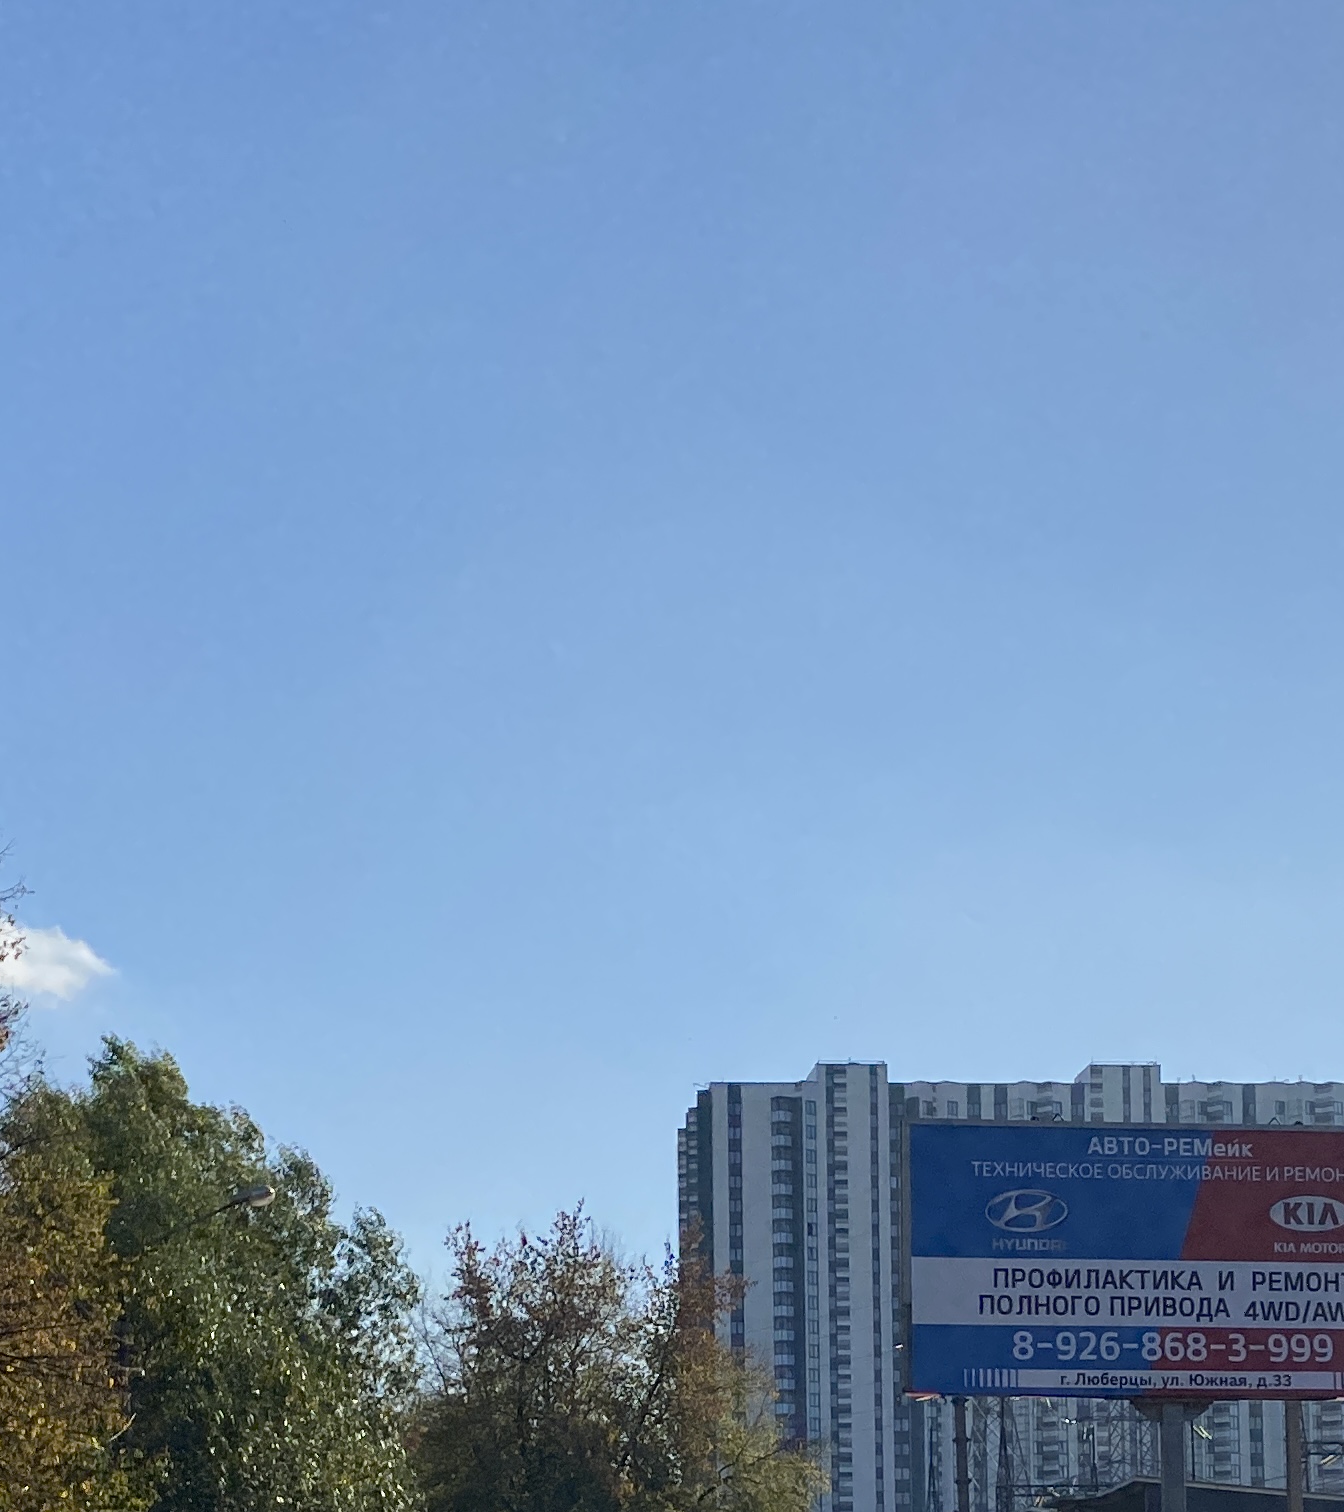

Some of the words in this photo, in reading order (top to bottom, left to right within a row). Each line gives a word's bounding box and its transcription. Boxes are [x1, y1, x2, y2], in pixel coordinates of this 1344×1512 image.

[1087, 1137, 1253, 1158] АВТО-РЕМейк
[971, 1161, 1103, 1179] ТЕХНИЧЕСКОЕ
[1107, 1163, 1262, 1182] ОБСЛУЖИВАНИЕ
[1266, 1166, 1279, 1181] И
[1283, 1201, 1340, 1225] KIA
[1273, 1242, 1296, 1253] KIA
[992, 1267, 1204, 1291] ПРОФИЛАКТИКА
[1218, 1271, 1235, 1291] И
[978, 1294, 1101, 1316] ПОЛНОГО
[1109, 1296, 1231, 1322] ПРИВОДА
[1012, 1330, 1334, 1363] 8-926-868-3-999
[1060, 1375, 1070, 1386] г.
[1074, 1373, 1157, 1389] Люберцы,
[1161, 1375, 1184, 1388] ул.
[1189, 1374, 1253, 1389] Южная,
[1256, 1374, 1292, 1388] д.33
